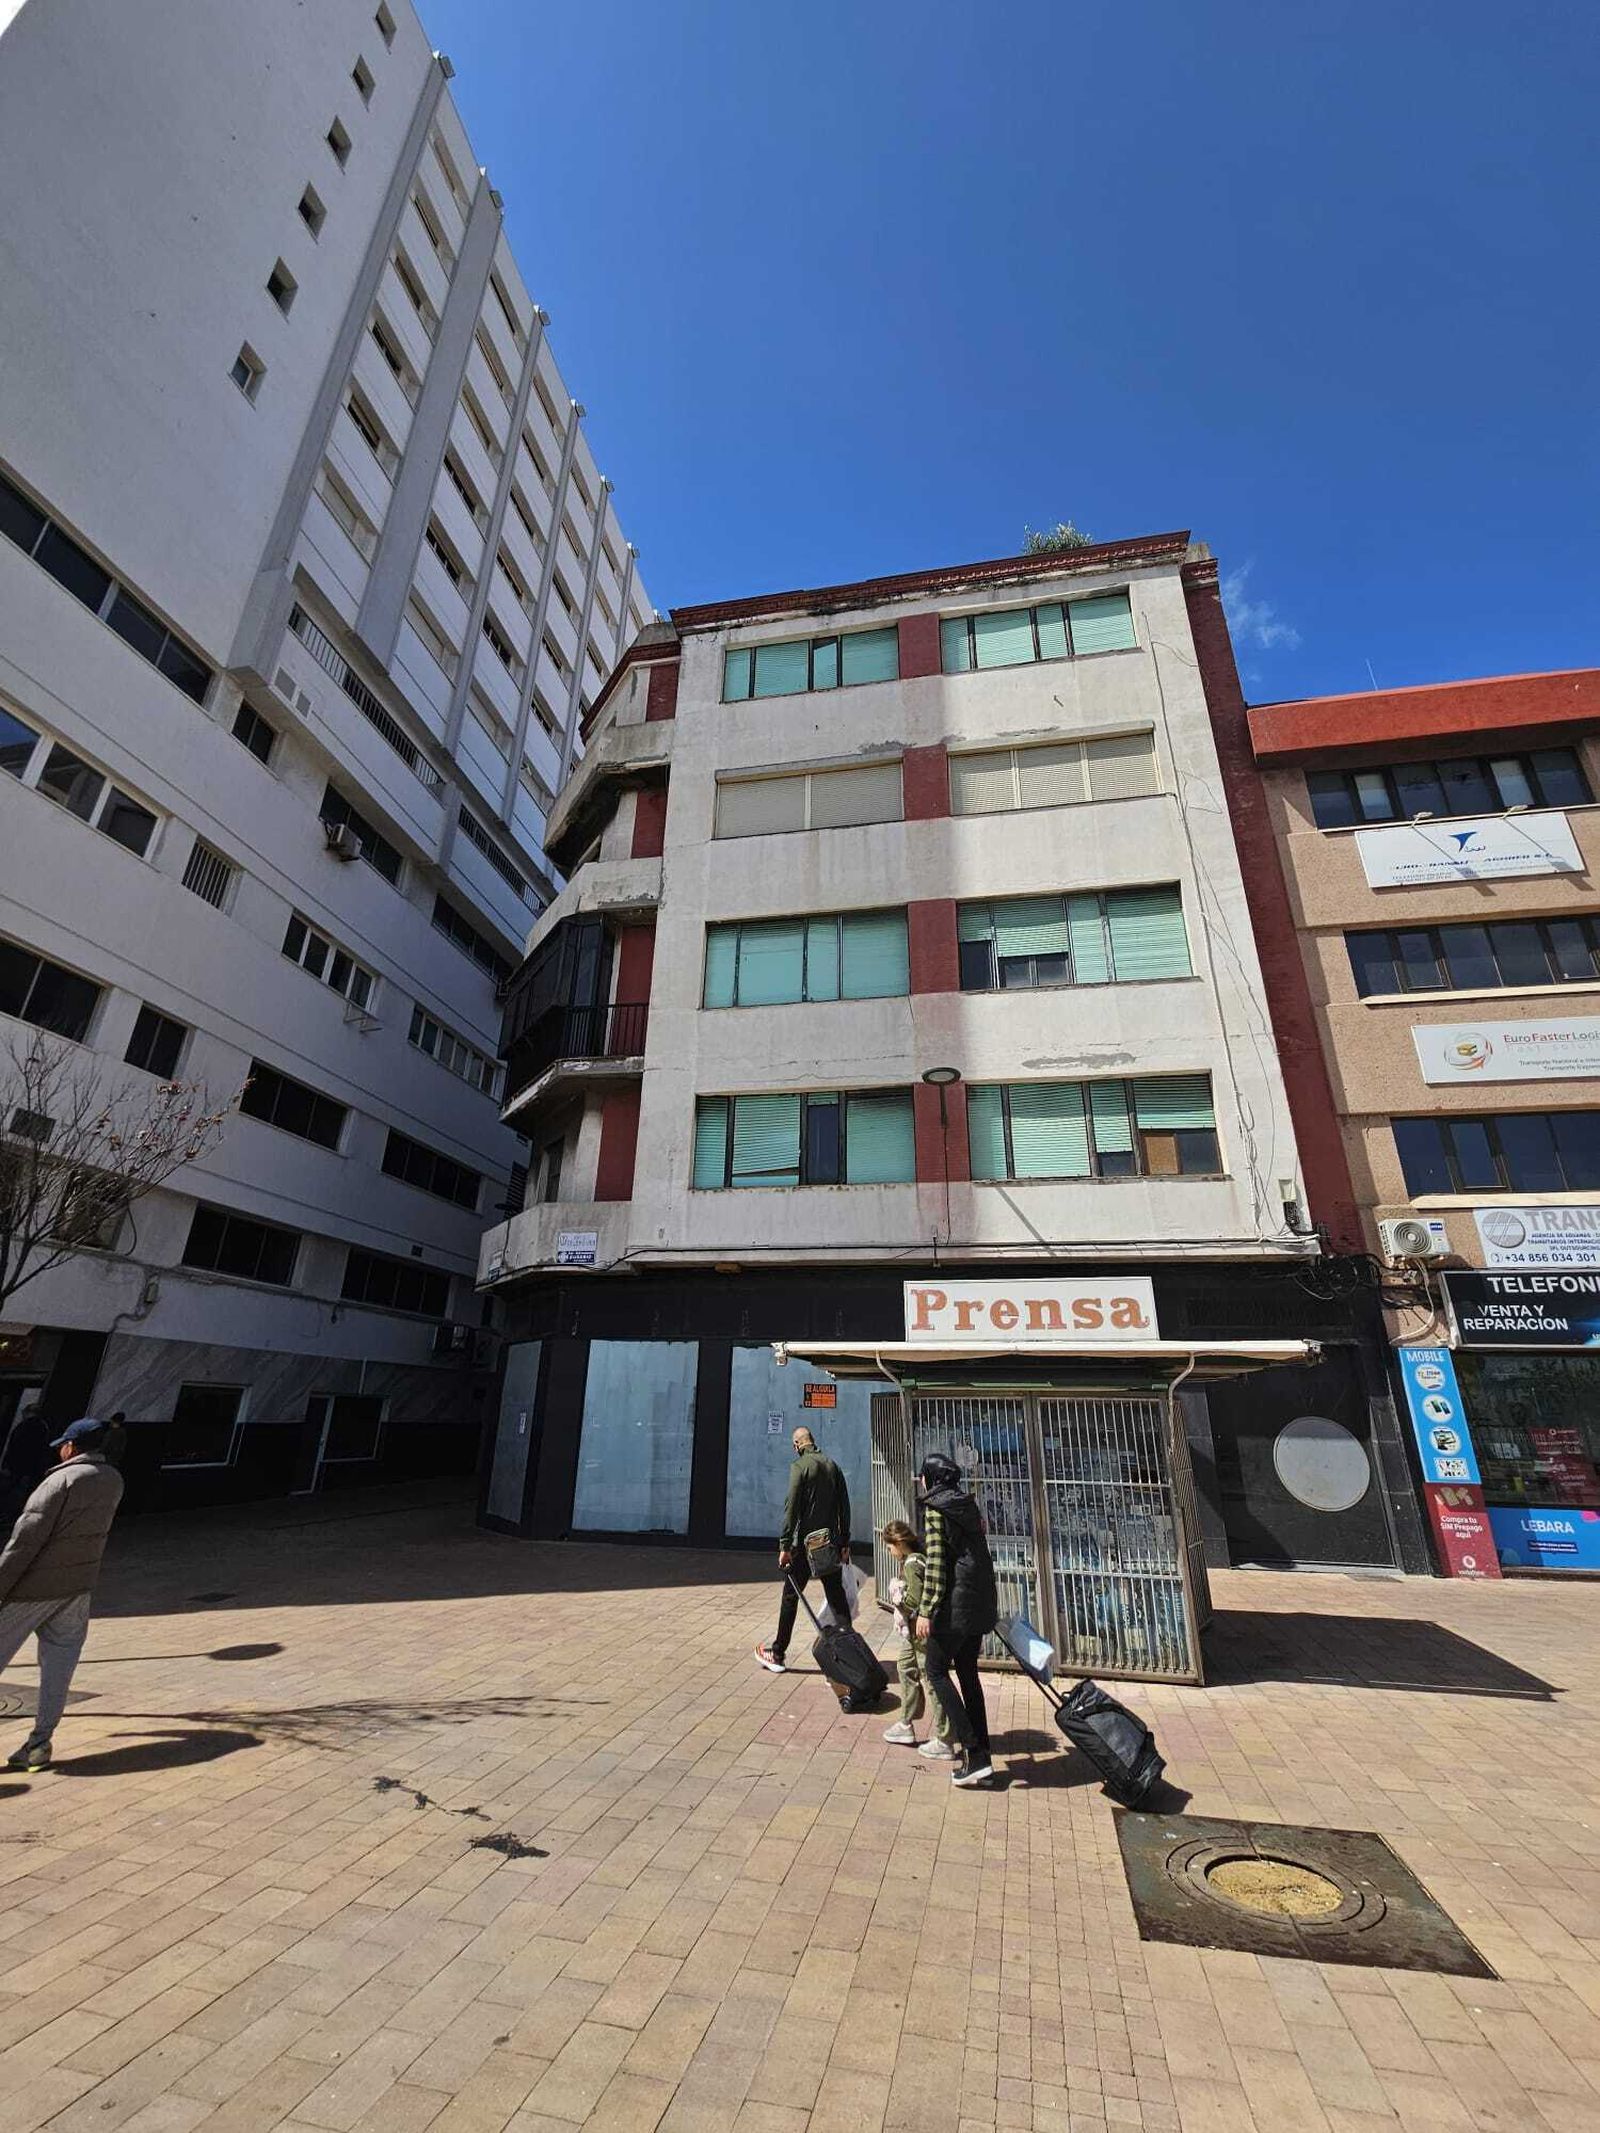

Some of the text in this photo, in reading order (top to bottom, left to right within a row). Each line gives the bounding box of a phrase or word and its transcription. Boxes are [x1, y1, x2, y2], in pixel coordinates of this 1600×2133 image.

[1505, 1253, 1597, 1262] +34 856 034 301
[911, 1288, 1150, 1331] Prensa
[1478, 1305, 1544, 1317] VENTA Y
[1463, 1318, 1569, 1330] REPARACION
[1406, 1350, 1445, 1362] MOBILE
[1440, 1515, 1468, 1524] Compra
[1440, 1522, 1483, 1532] SIM Prepago
[1520, 1519, 1575, 1534] LEBARA
